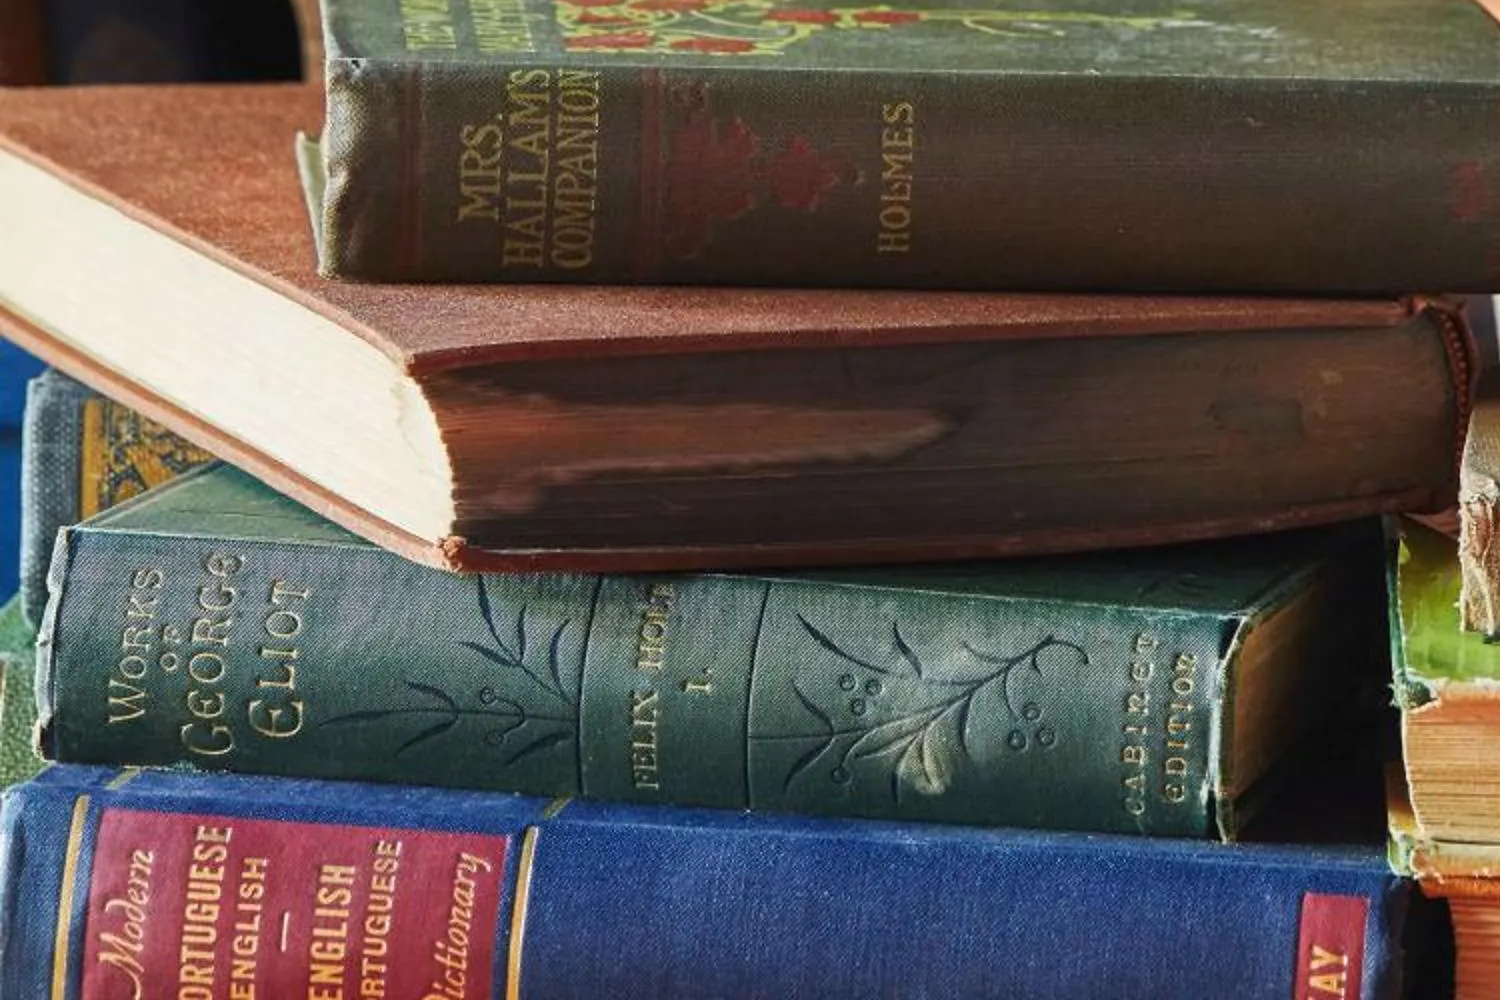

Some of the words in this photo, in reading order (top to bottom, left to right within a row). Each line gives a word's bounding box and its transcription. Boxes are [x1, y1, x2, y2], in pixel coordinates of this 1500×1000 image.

[457, 113, 503, 224] MRS.
[551, 67, 600, 269] COMPANION
[878, 102, 914, 253] HOLMES
[180, 552, 247, 755] GEORGE
[248, 576, 310, 738] ELIOT
[632, 689, 661, 791] FELIX
[97, 849, 155, 1000] Modern
[230, 856, 268, 1000] ENGLISH
[308, 863, 356, 1000] ENGLISH
[359, 839, 403, 1000] RTUGUESE
[1307, 945, 1349, 1000] AY
